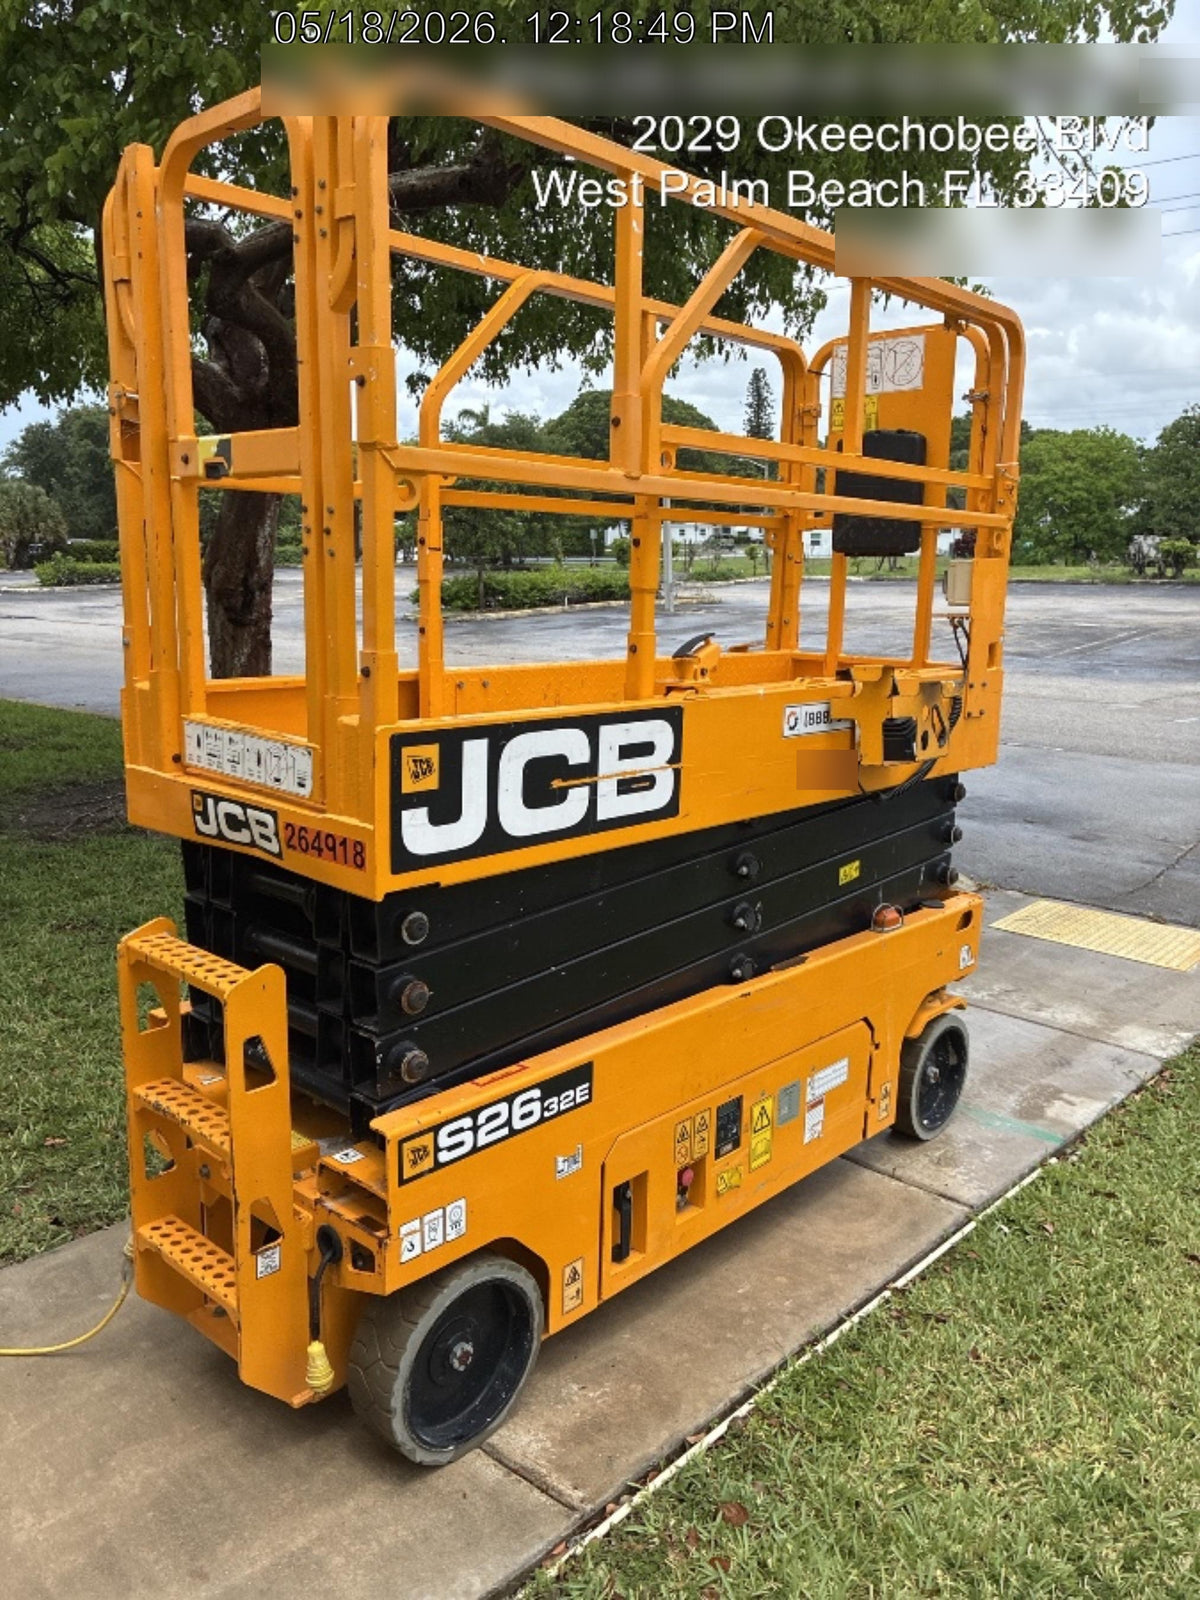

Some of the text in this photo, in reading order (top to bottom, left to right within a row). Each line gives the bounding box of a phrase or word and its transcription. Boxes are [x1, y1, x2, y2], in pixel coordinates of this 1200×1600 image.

[194, 797, 366, 869] JCB 264918
[400, 718, 675, 856] JCB
